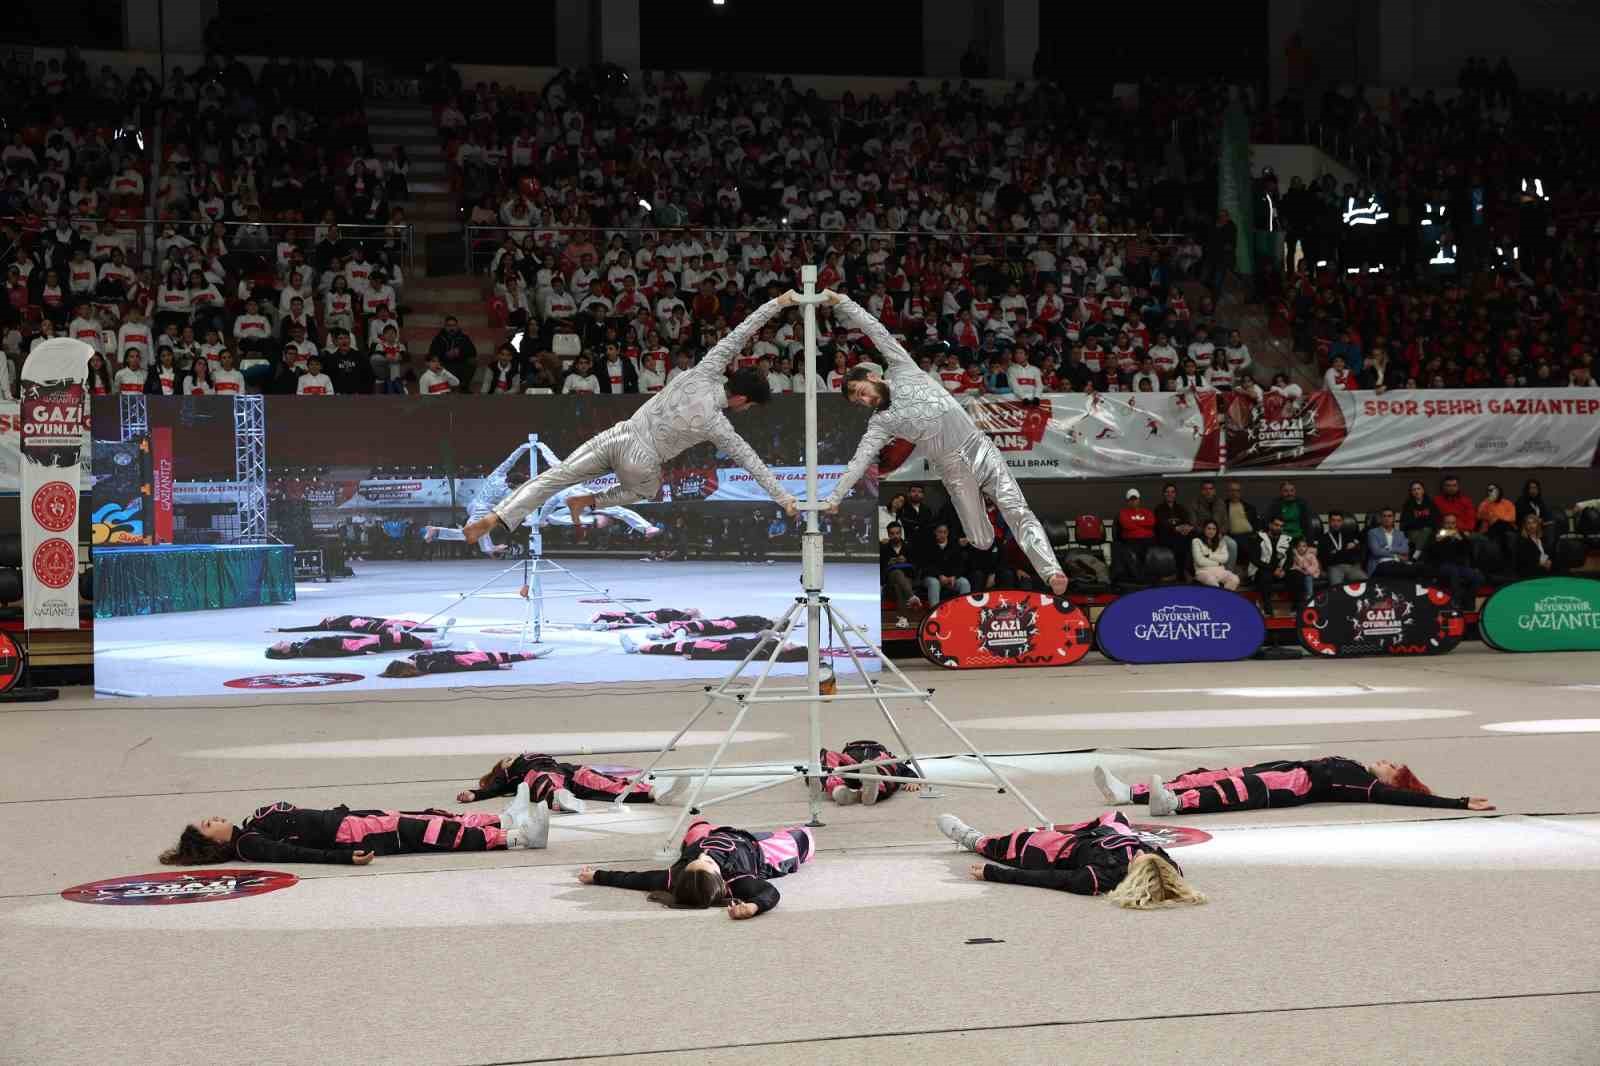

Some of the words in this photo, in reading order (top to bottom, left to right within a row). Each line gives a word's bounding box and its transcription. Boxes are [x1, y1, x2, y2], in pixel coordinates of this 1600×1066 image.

[32, 404, 83, 423] GAZİ
[1364, 400, 1419, 416] SPOR
[1424, 399, 1483, 418] ŞEHRİ
[1488, 399, 1600, 416] GAZİANTEP
[1027, 459, 1060, 468] BRANŞ
[1366, 608, 1396, 621] GAZİ
[990, 618, 1021, 631] GAZİ
[986, 630, 1028, 640] OYUNLARI
